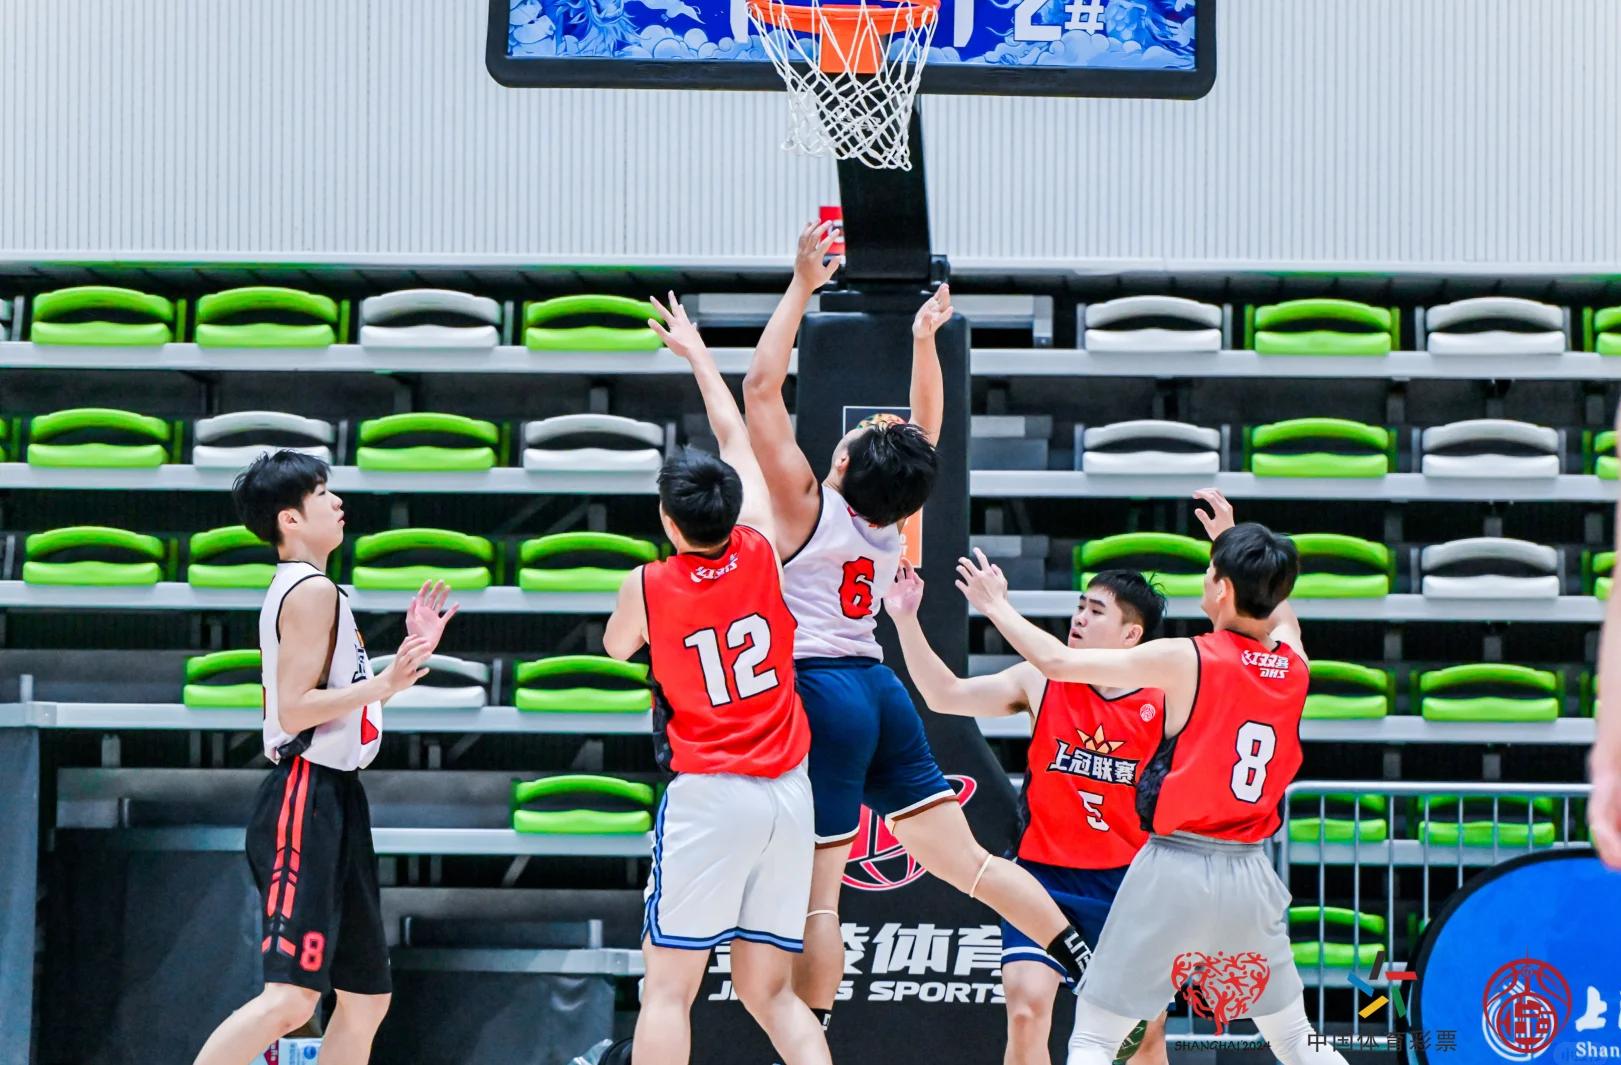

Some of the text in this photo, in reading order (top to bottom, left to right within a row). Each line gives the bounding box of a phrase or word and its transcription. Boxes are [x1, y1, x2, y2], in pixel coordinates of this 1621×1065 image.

[838, 555, 875, 619] 6
[683, 612, 779, 707] 12
[1259, 668, 1289, 679] DHS
[1048, 740, 1139, 786] 上冠联赛
[1229, 720, 1277, 804] 8
[1078, 790, 1110, 832] 5
[299, 931, 326, 972] 8
[867, 980, 1006, 1004] SPORTS
